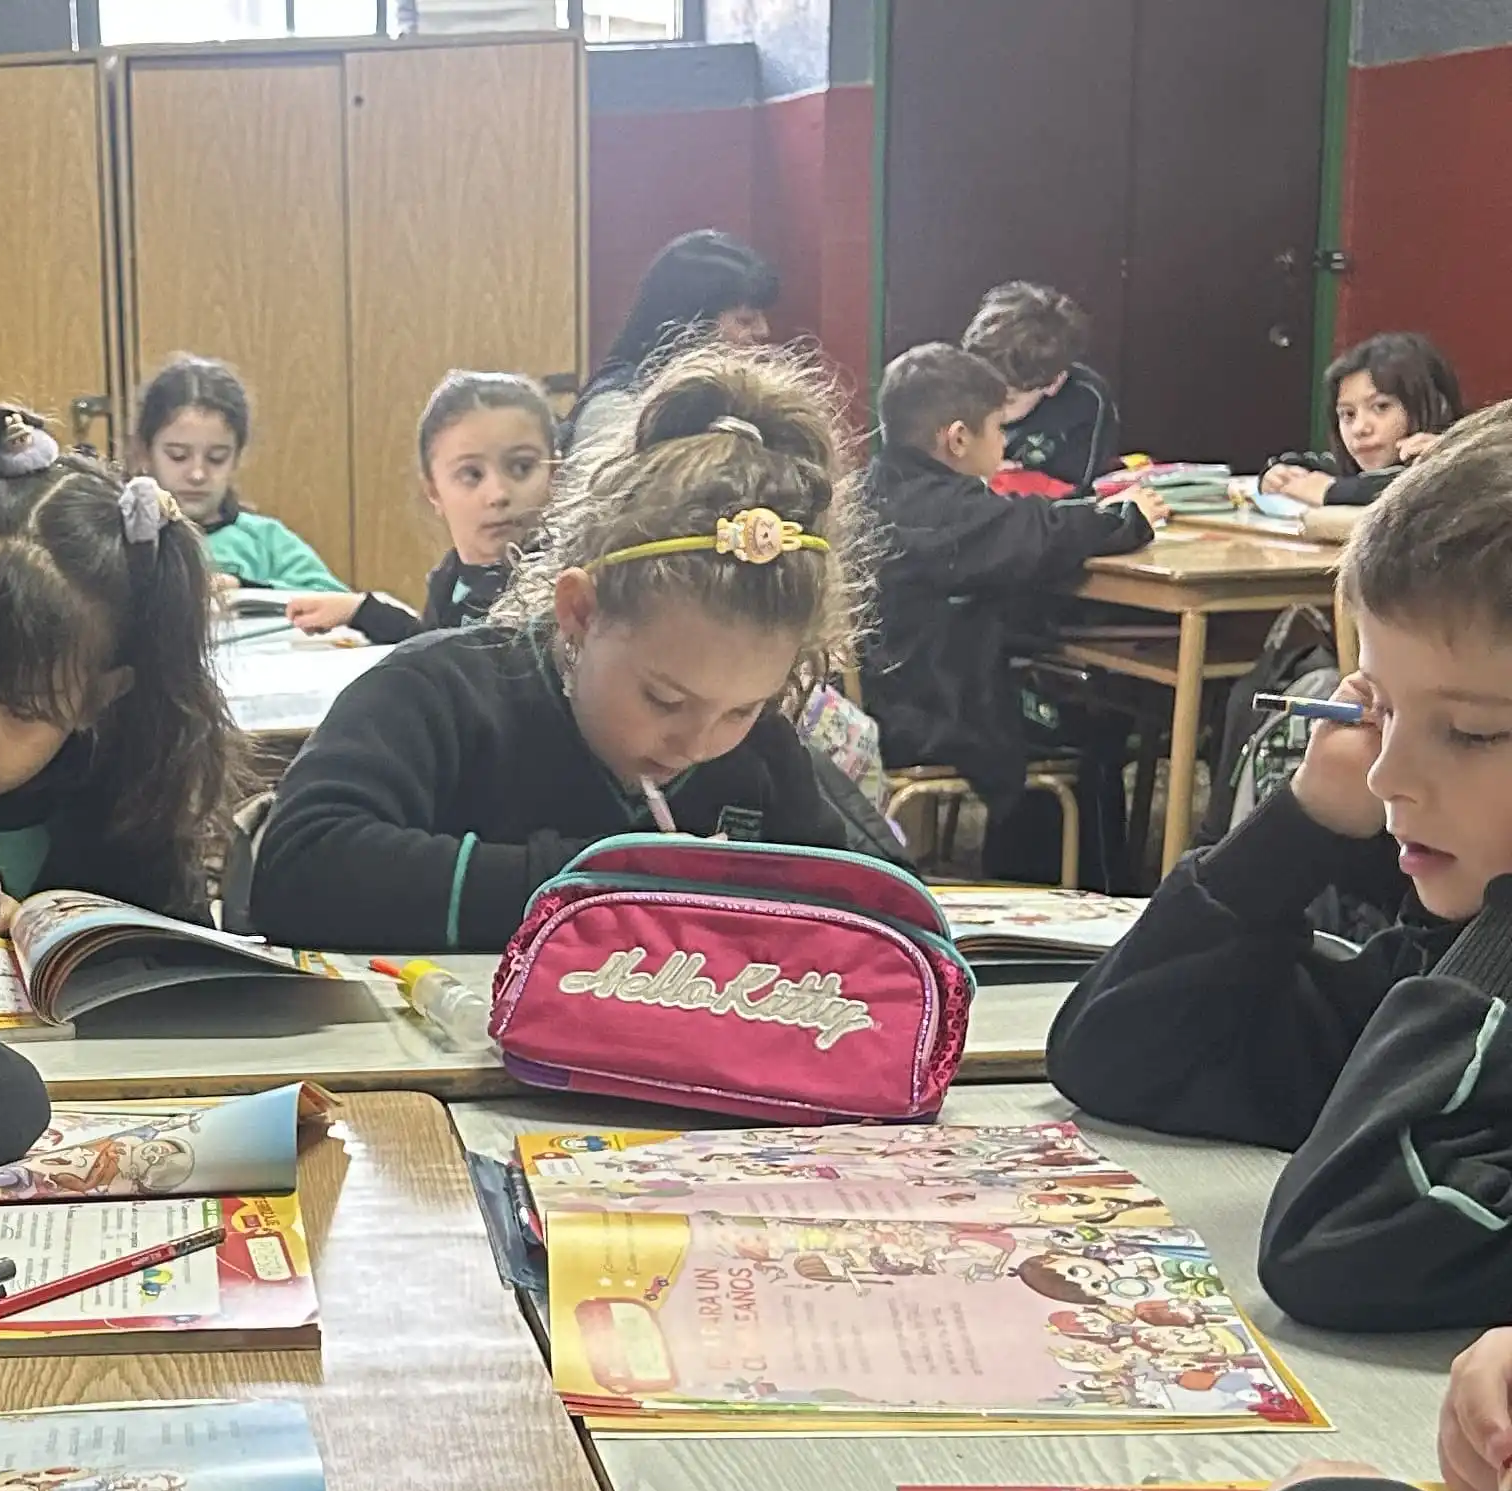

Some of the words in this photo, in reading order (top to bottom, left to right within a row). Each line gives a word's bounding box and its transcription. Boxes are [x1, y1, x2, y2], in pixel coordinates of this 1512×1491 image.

[558, 946, 718, 1011] Hello
[712, 963, 875, 1051] Kitty
[692, 1266, 720, 1290] UN
